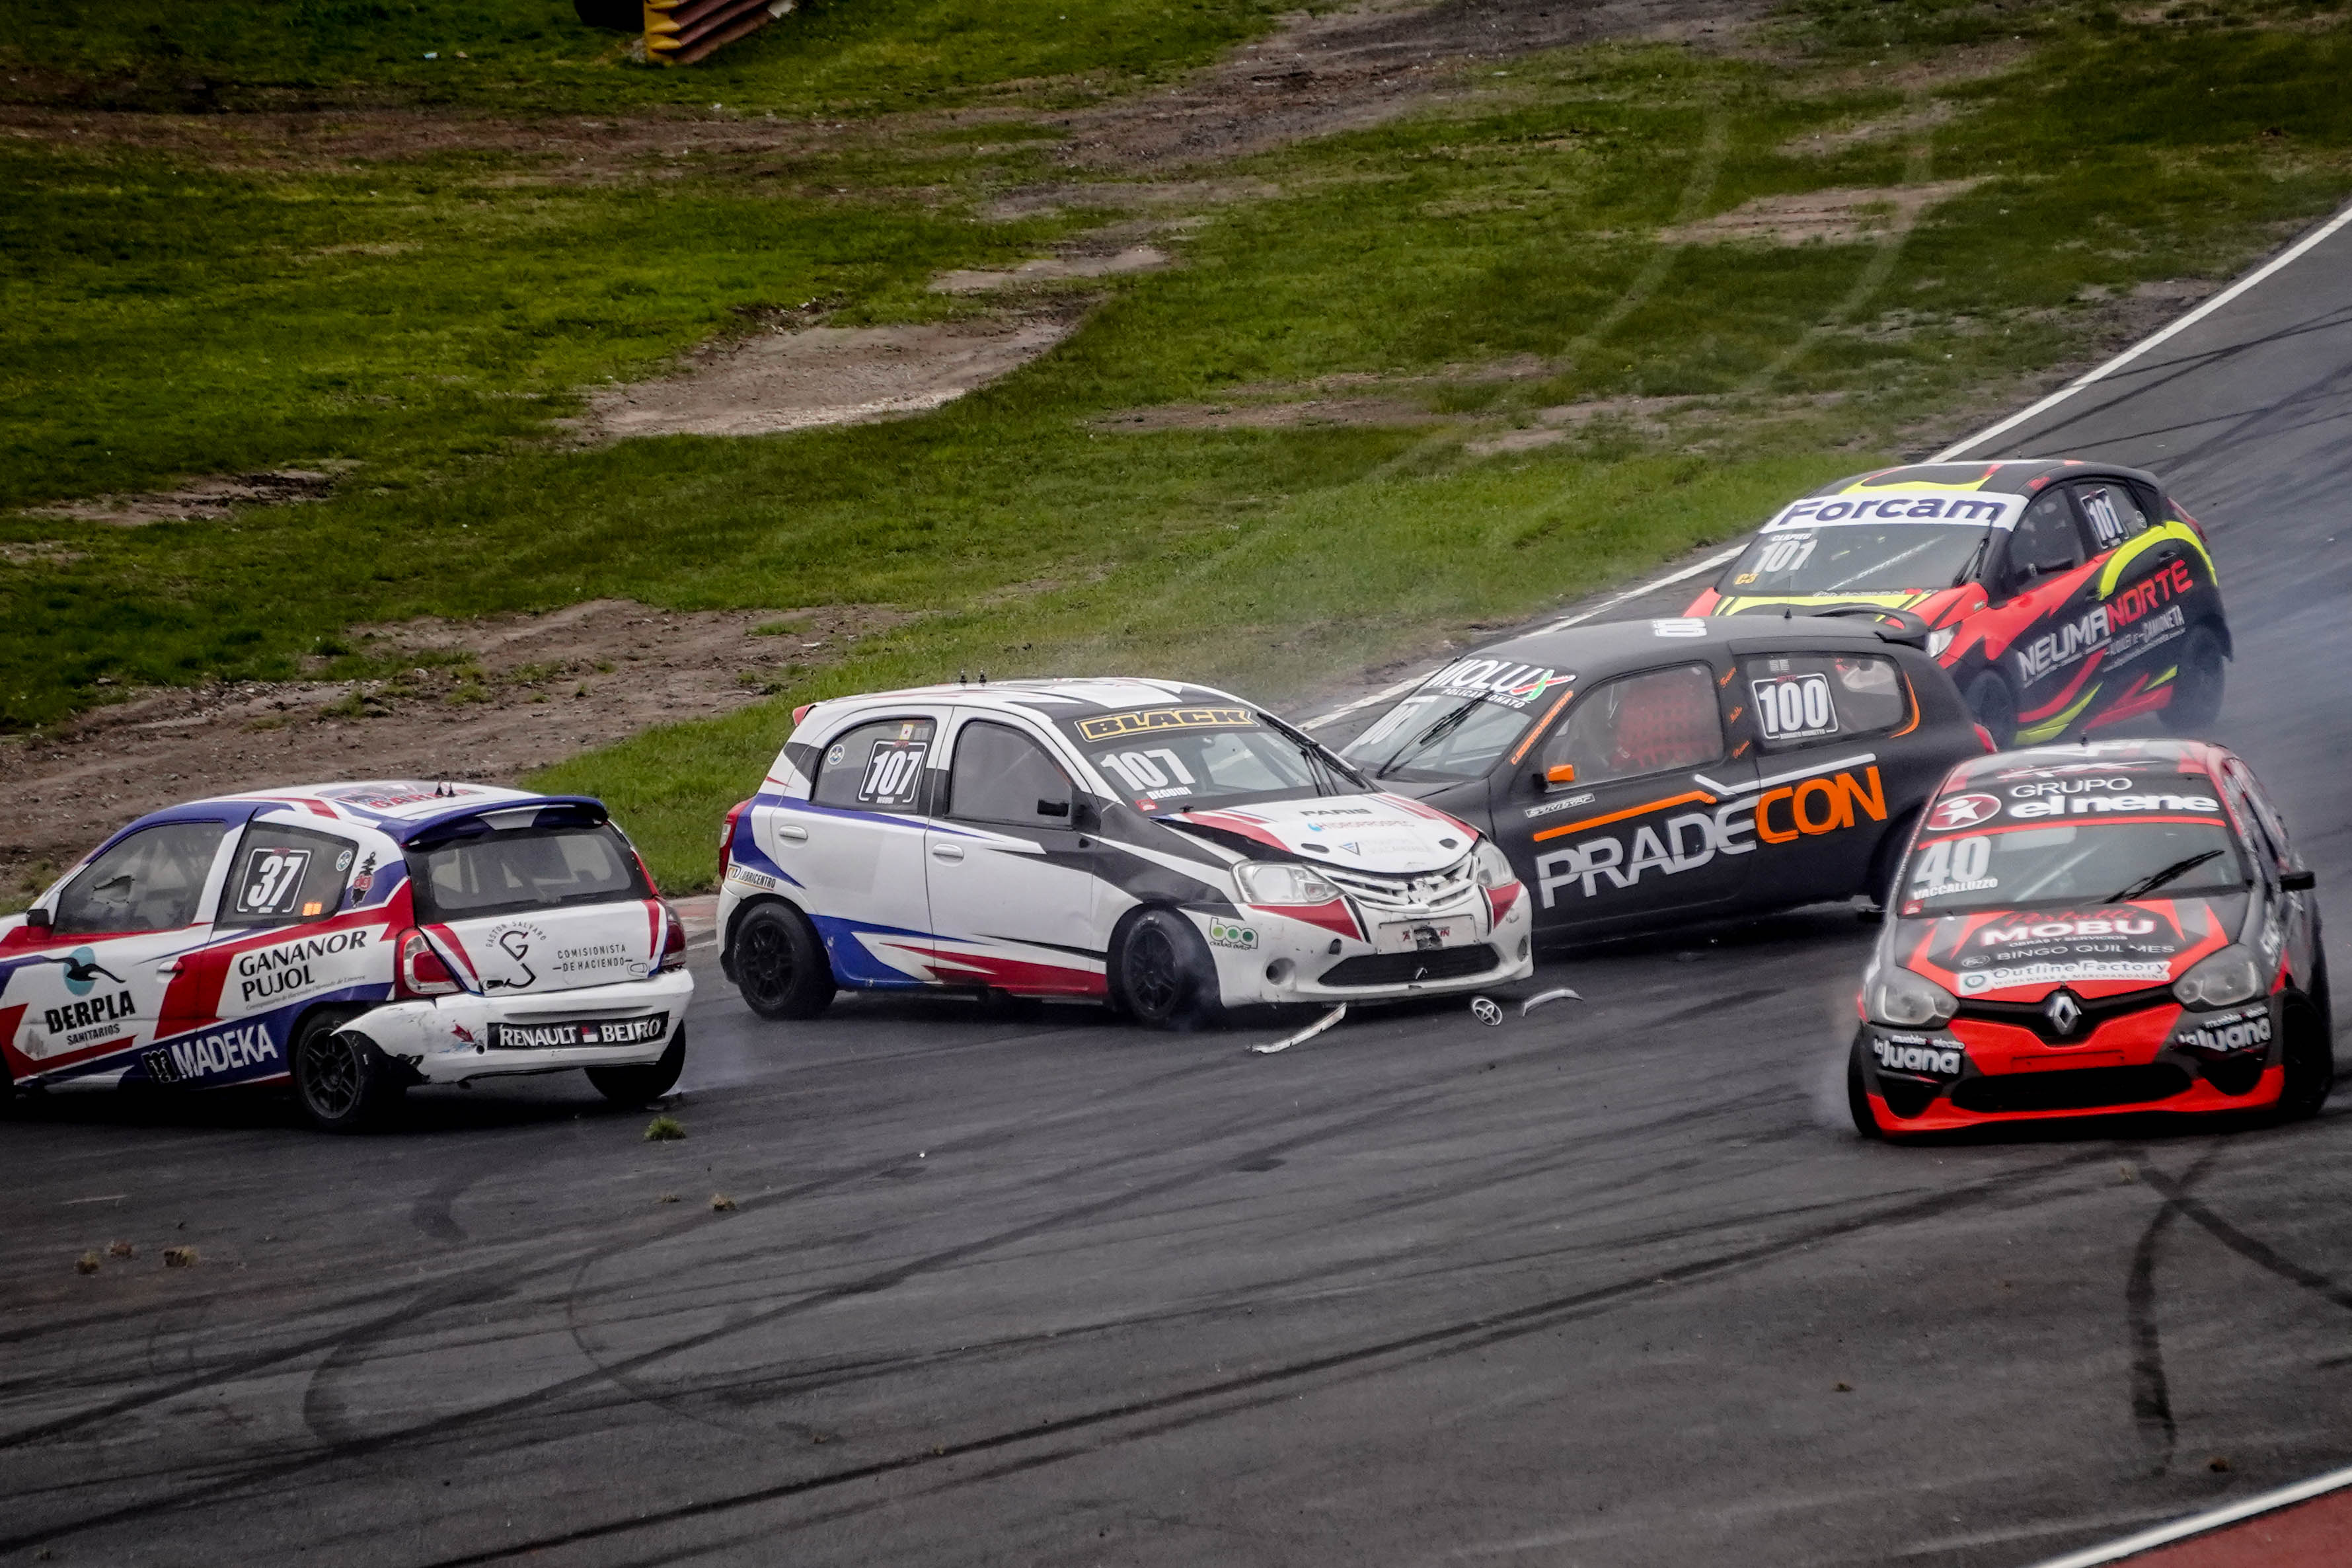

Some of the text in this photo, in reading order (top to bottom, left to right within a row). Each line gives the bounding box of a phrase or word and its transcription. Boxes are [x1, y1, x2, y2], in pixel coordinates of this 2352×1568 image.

[1778, 499, 2009, 525] Forcam
[2089, 496, 2123, 541] 101
[1753, 539, 1818, 574] 101
[2018, 560, 2193, 681] NEUMANORTE
[1080, 709, 1255, 739] BLACK
[1759, 679, 1829, 733] 100
[865, 751, 923, 796] 107
[1100, 748, 1195, 792] 107
[2011, 778, 2133, 798] GRUPO
[1535, 766, 1888, 909] PRADECON
[1915, 835, 1992, 889] 40
[247, 855, 303, 907] 37
[1983, 918, 2156, 946] MOBU
[2009, 938, 2050, 948] OBRAS
[239, 930, 367, 977] GANANOR
[558, 944, 626, 959] COMISIONISTA
[563, 962, 574, 972] DE
[1997, 946, 2068, 960] BINGO
[242, 964, 315, 1002] PUJOL
[1992, 962, 2074, 978] Outline
[2082, 962, 2166, 973] Factory
[44, 990, 135, 1034] DERPLA
[67, 1024, 121, 1045] SANITARIOS
[171, 1022, 278, 1079] MADEKA
[499, 1019, 662, 1046] RENAULT BEIRO
